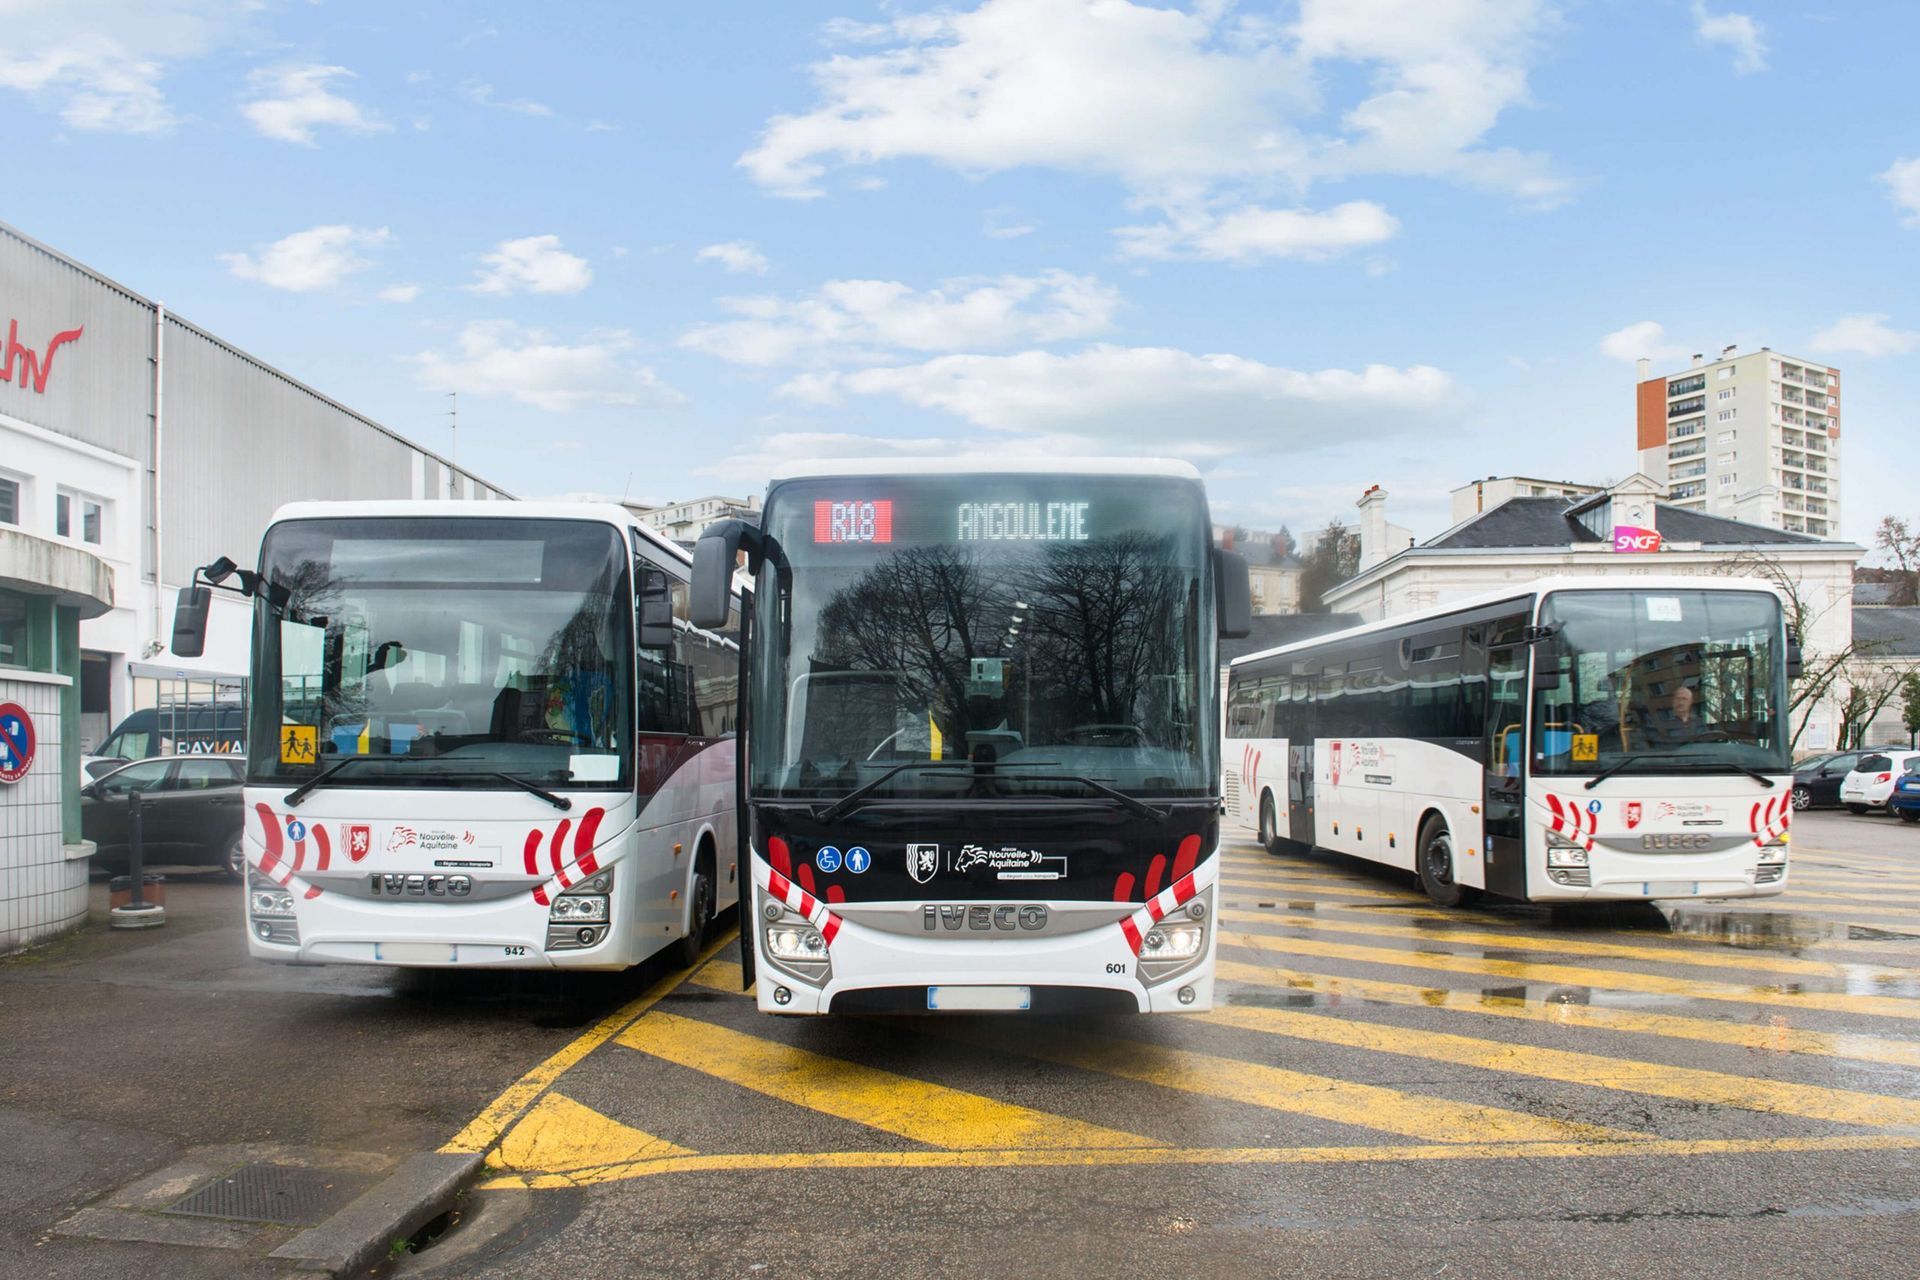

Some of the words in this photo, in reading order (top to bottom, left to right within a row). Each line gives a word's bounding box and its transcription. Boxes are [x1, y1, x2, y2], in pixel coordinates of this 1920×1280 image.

[831, 503, 875, 540] R18
[958, 502, 1089, 540] ANGOULEME
[1616, 535, 1659, 550] SNCF
[419, 832, 459, 841] Nouvelle-
[420, 841, 458, 851] Aquitaine
[988, 850, 1030, 859] Nouvelle-
[988, 859, 1030, 870] Aquitaine
[371, 873, 472, 897] IVECO
[924, 904, 1048, 931] IVECO
[504, 945, 526, 956] 942
[1105, 963, 1127, 975] 601
